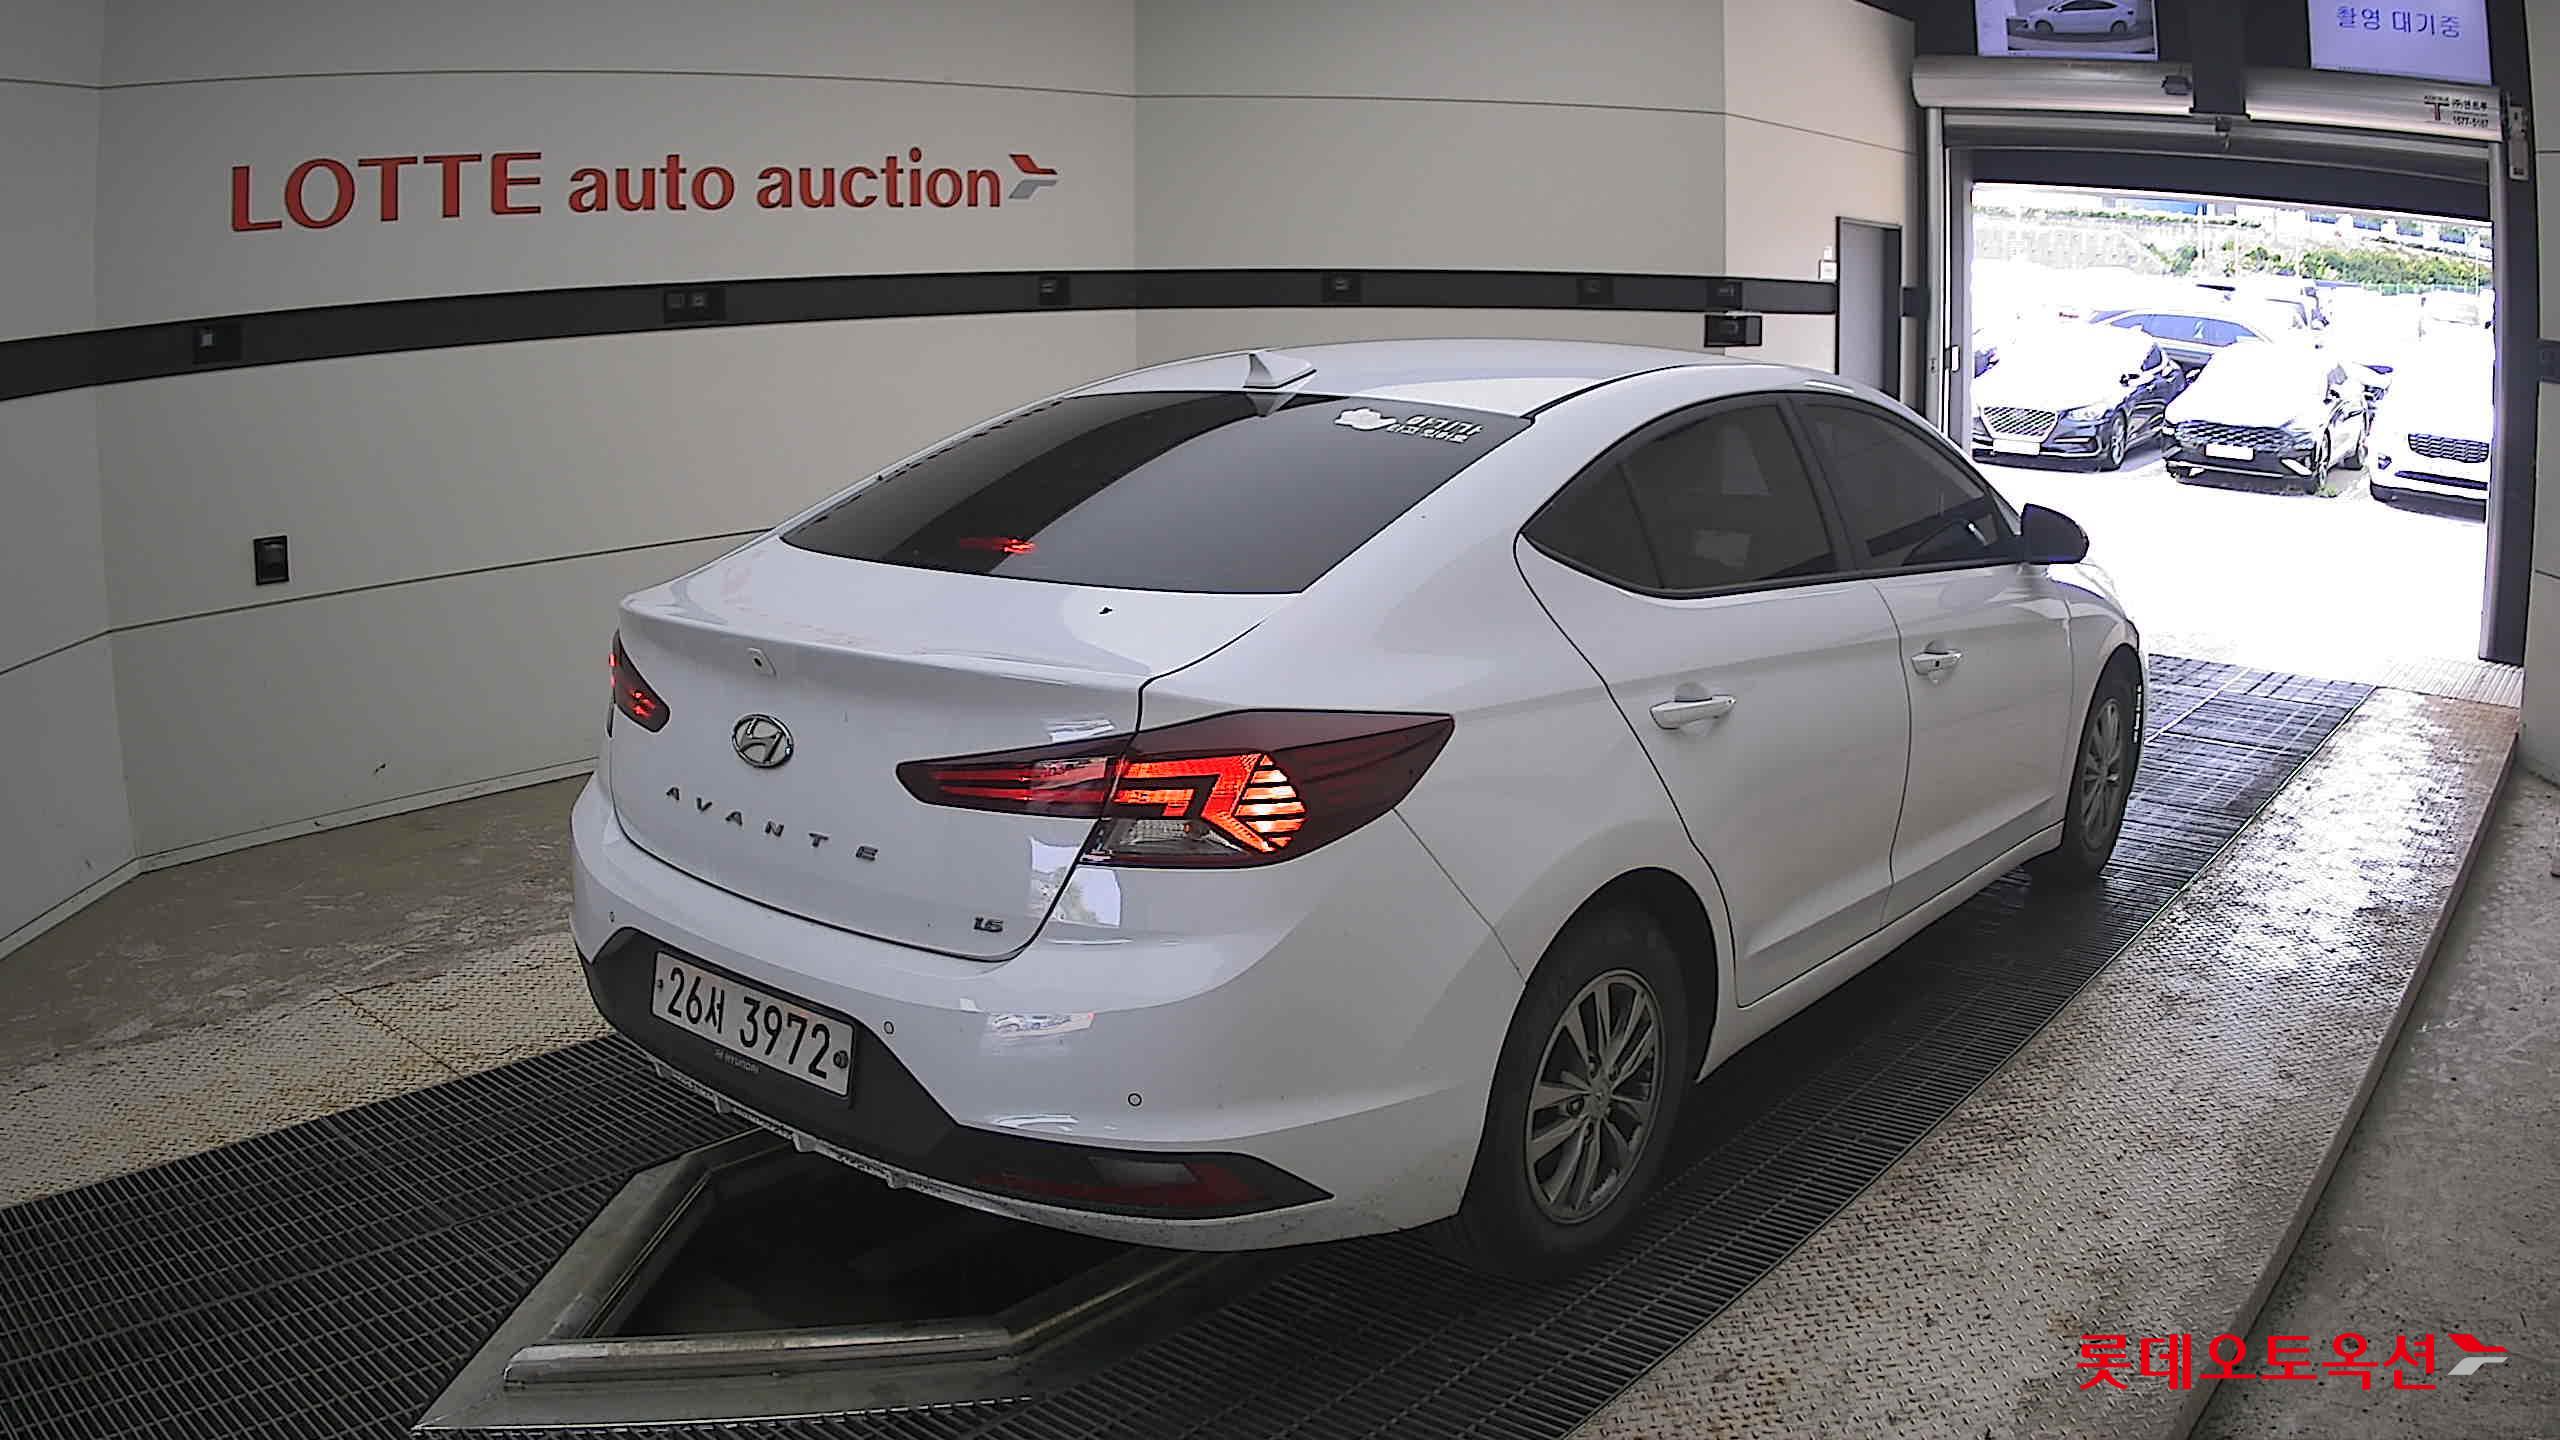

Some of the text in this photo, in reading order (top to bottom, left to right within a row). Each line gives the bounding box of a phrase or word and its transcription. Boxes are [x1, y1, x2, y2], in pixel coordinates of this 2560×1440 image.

[2337, 6, 2461, 39] 촬영 대기중
[231, 147, 1000, 232] LOTTE auto auction
[665, 786, 879, 862] AVANTE
[667, 967, 830, 1080] 26서 3972
